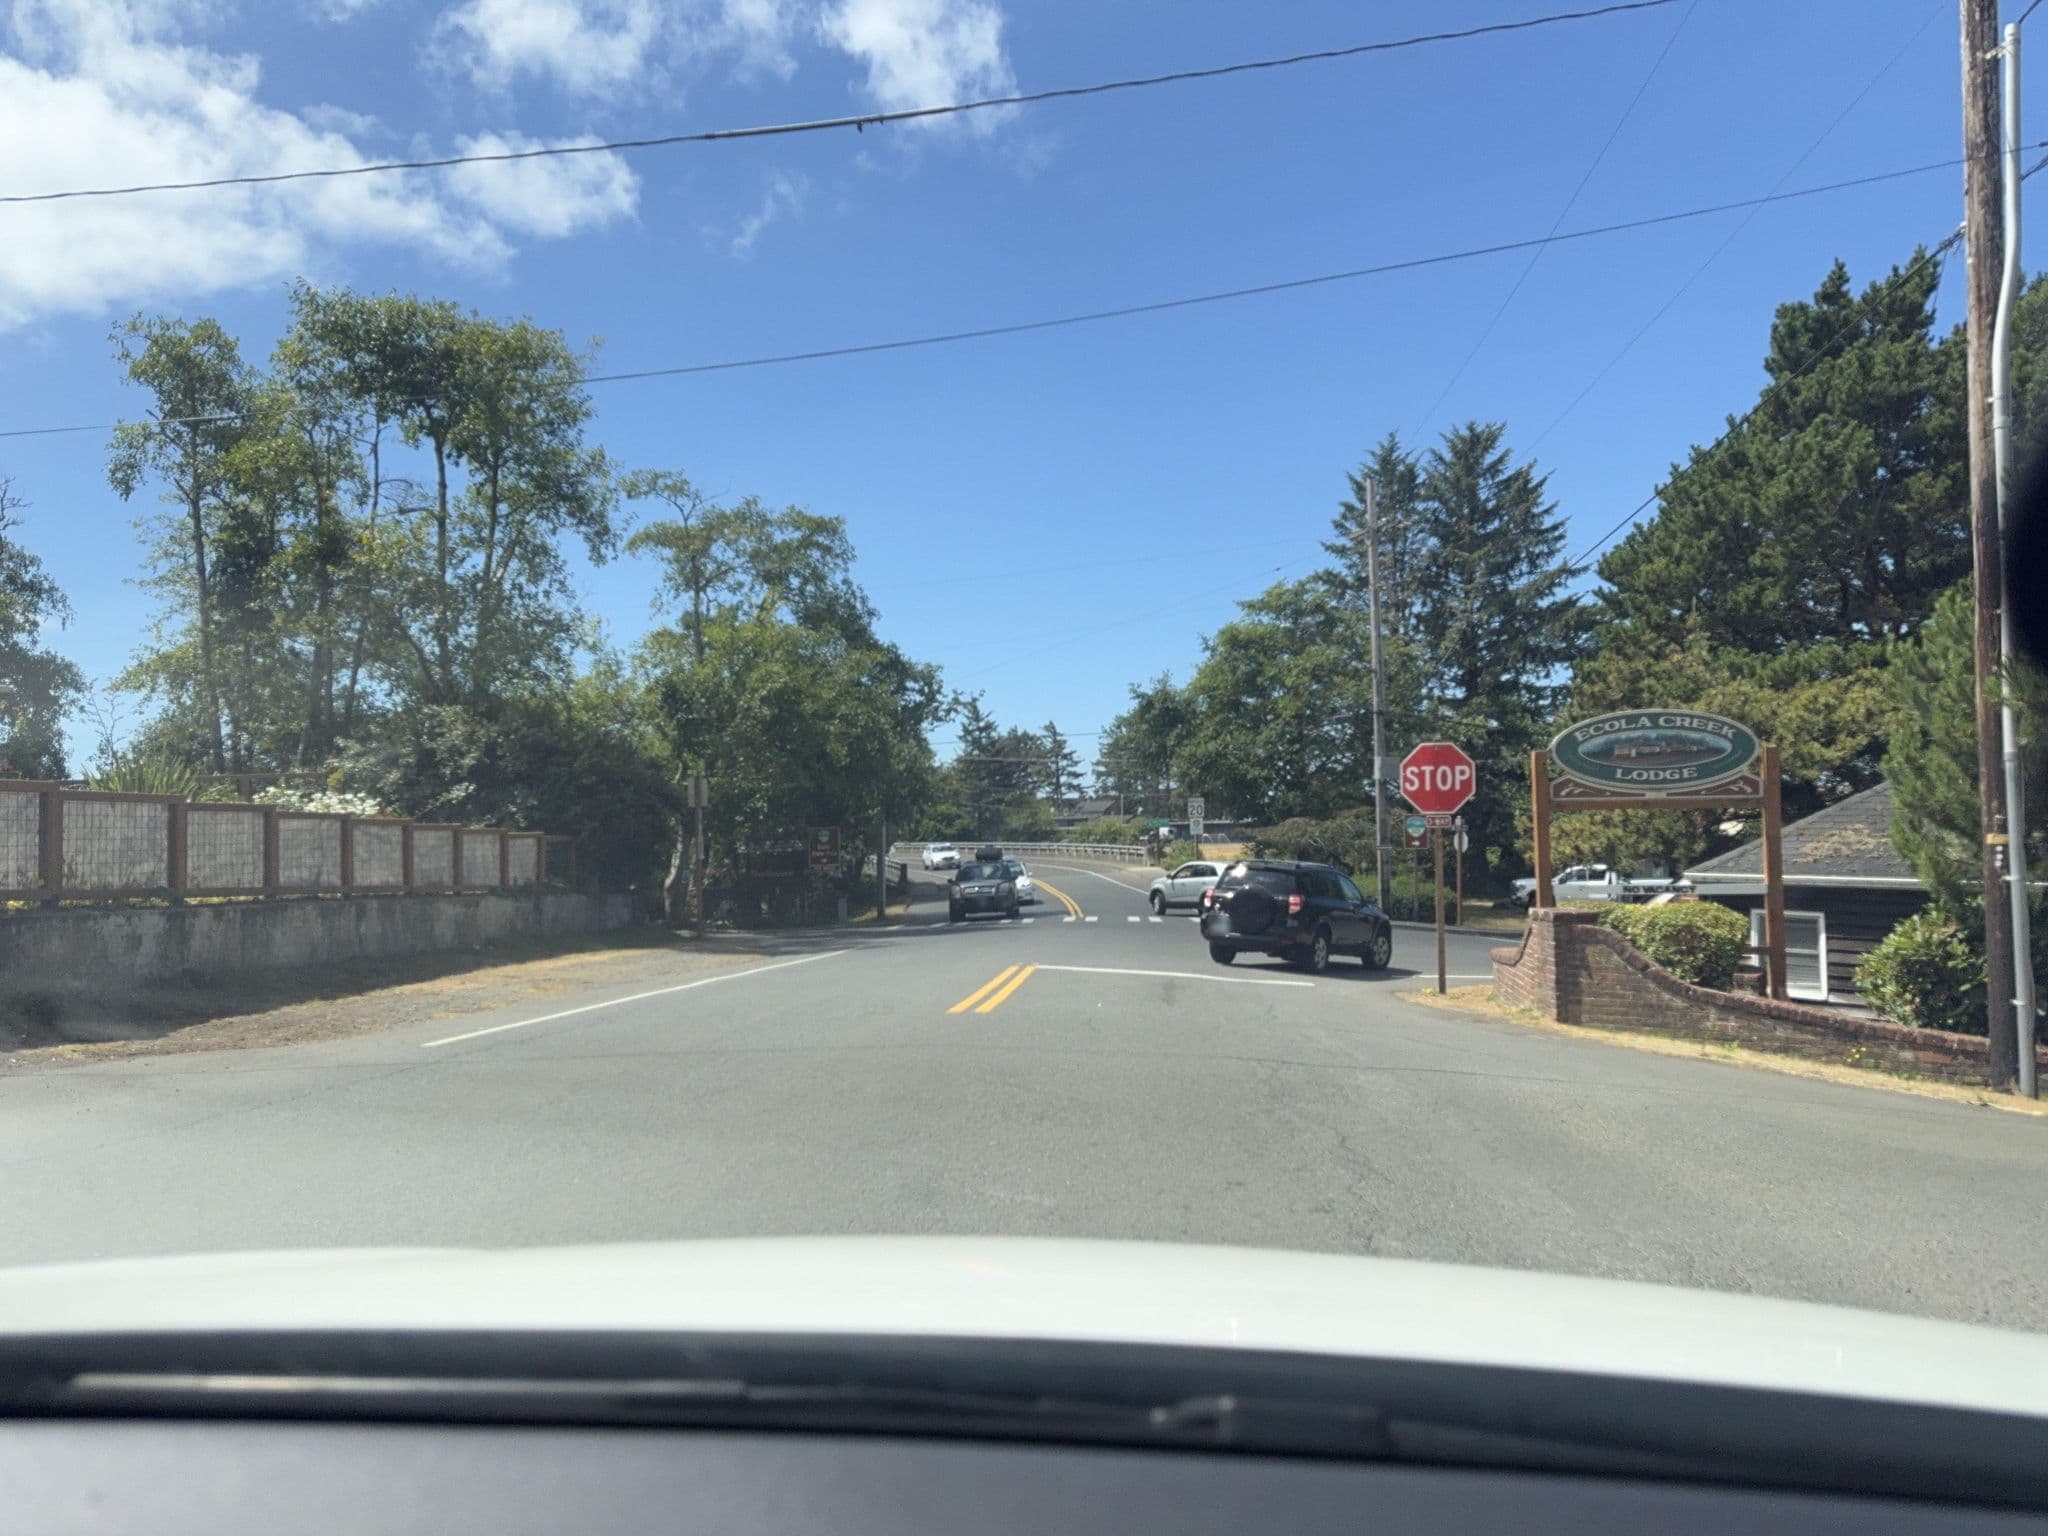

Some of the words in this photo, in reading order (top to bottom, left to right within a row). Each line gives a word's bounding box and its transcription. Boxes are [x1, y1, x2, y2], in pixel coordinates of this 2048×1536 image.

[1574, 716, 1651, 742] ECOLA
[1658, 716, 1737, 740] CREEK
[1405, 765, 1471, 791] STOP
[1615, 767, 1699, 781] LODGE
[1190, 804, 1203, 816] 20
[1623, 885, 1640, 893] NO
[1643, 885, 1697, 894] VACANCY
